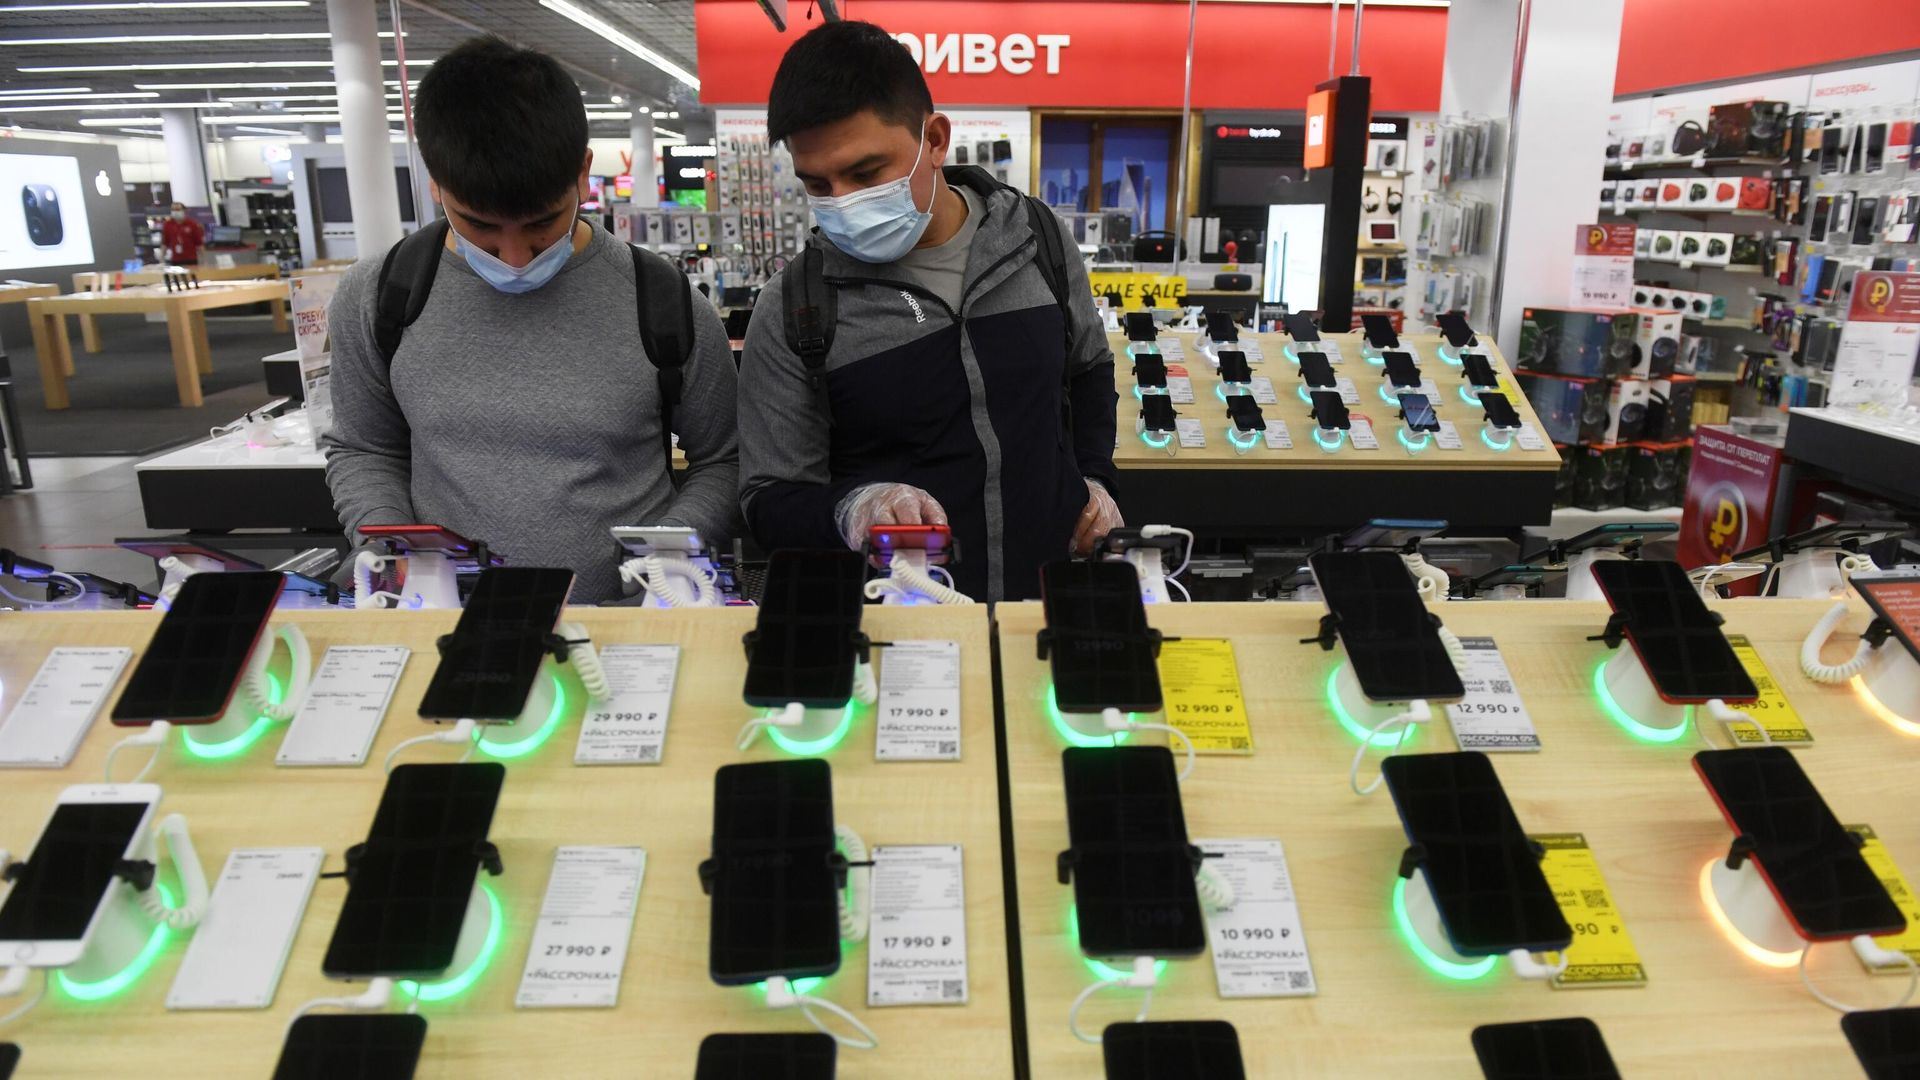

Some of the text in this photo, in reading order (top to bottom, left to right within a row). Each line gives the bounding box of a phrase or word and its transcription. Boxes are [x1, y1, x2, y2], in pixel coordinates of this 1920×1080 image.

[1093, 283, 1183, 299] SALE SALE
[900, 290, 926, 323] Reebok
[296, 305, 326, 324] ТРЕБУЙ
[890, 708, 903, 717] 17
[906, 708, 933, 717] 990
[1175, 704, 1188, 712] 12
[1193, 704, 1219, 713] 990
[1457, 704, 1473, 713] 12
[1477, 704, 1507, 713] 990
[594, 712, 611, 721] 29
[615, 712, 642, 721] 990
[1221, 929, 1238, 940] 10
[1243, 928, 1274, 940] 990
[883, 937, 898, 948] 17
[903, 937, 934, 948] 990
[545, 945, 562, 956] 27
[567, 945, 595, 956] 990
